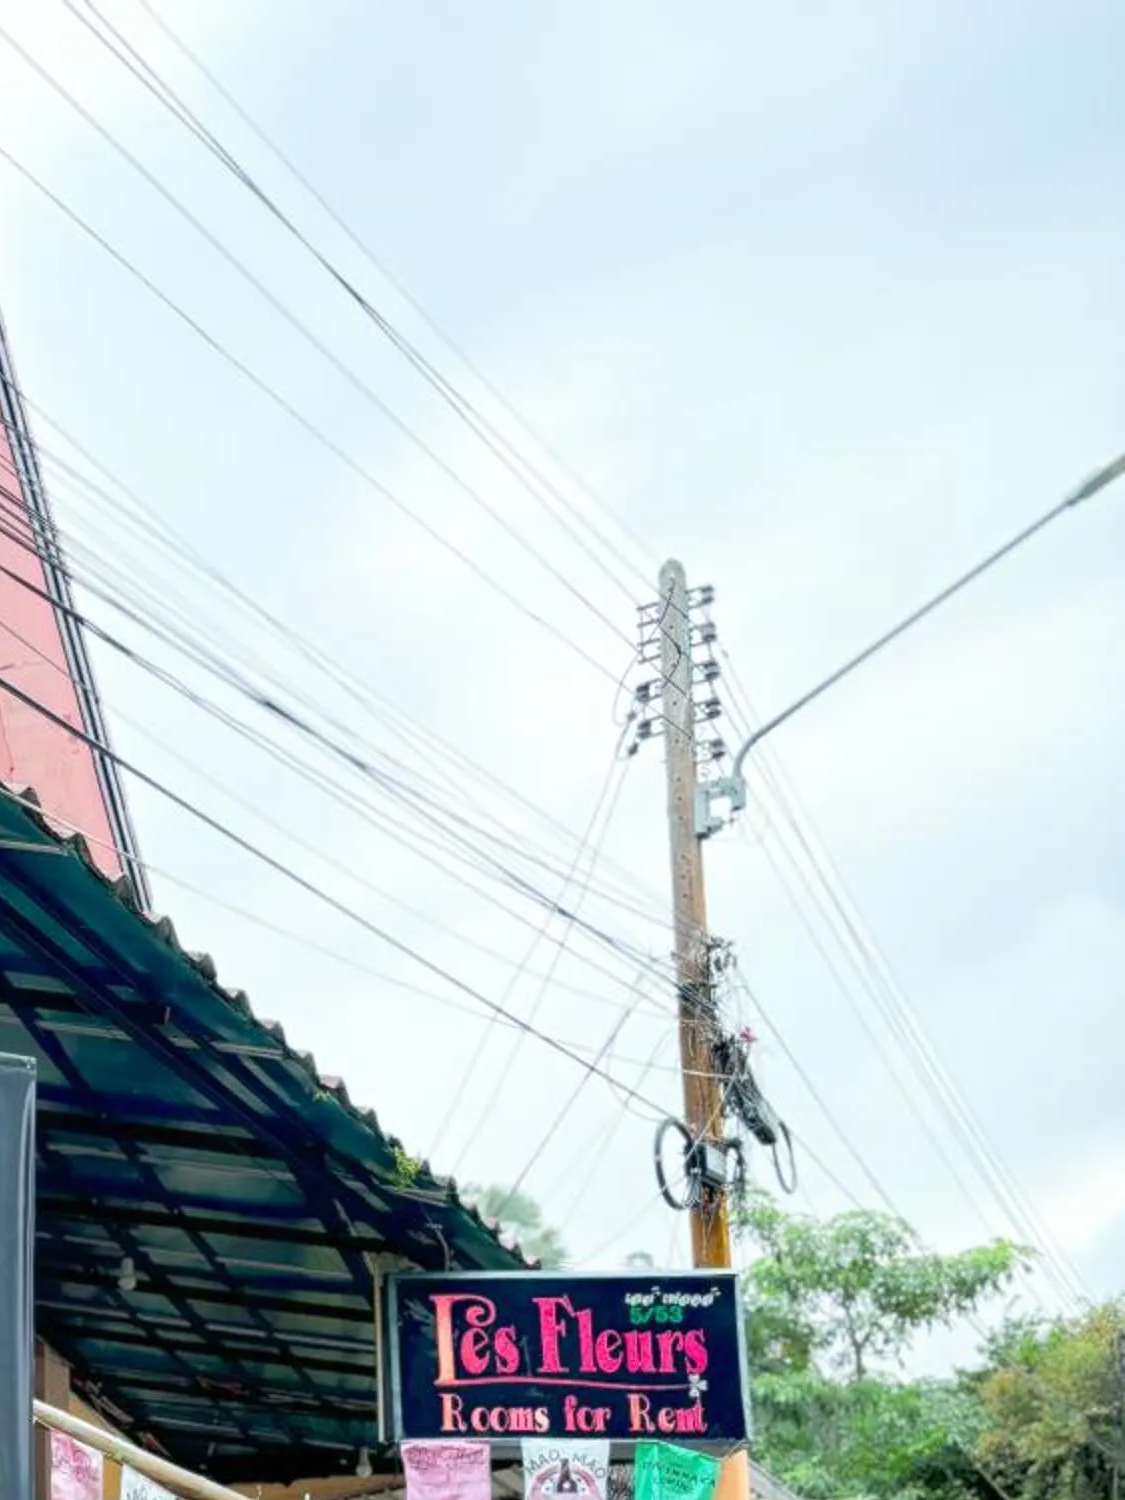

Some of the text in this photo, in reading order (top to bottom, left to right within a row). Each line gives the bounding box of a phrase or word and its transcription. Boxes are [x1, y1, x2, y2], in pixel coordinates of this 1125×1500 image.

[532, 1294, 709, 1374] Fleurs
[439, 1392, 708, 1433] Rooms for Rent
